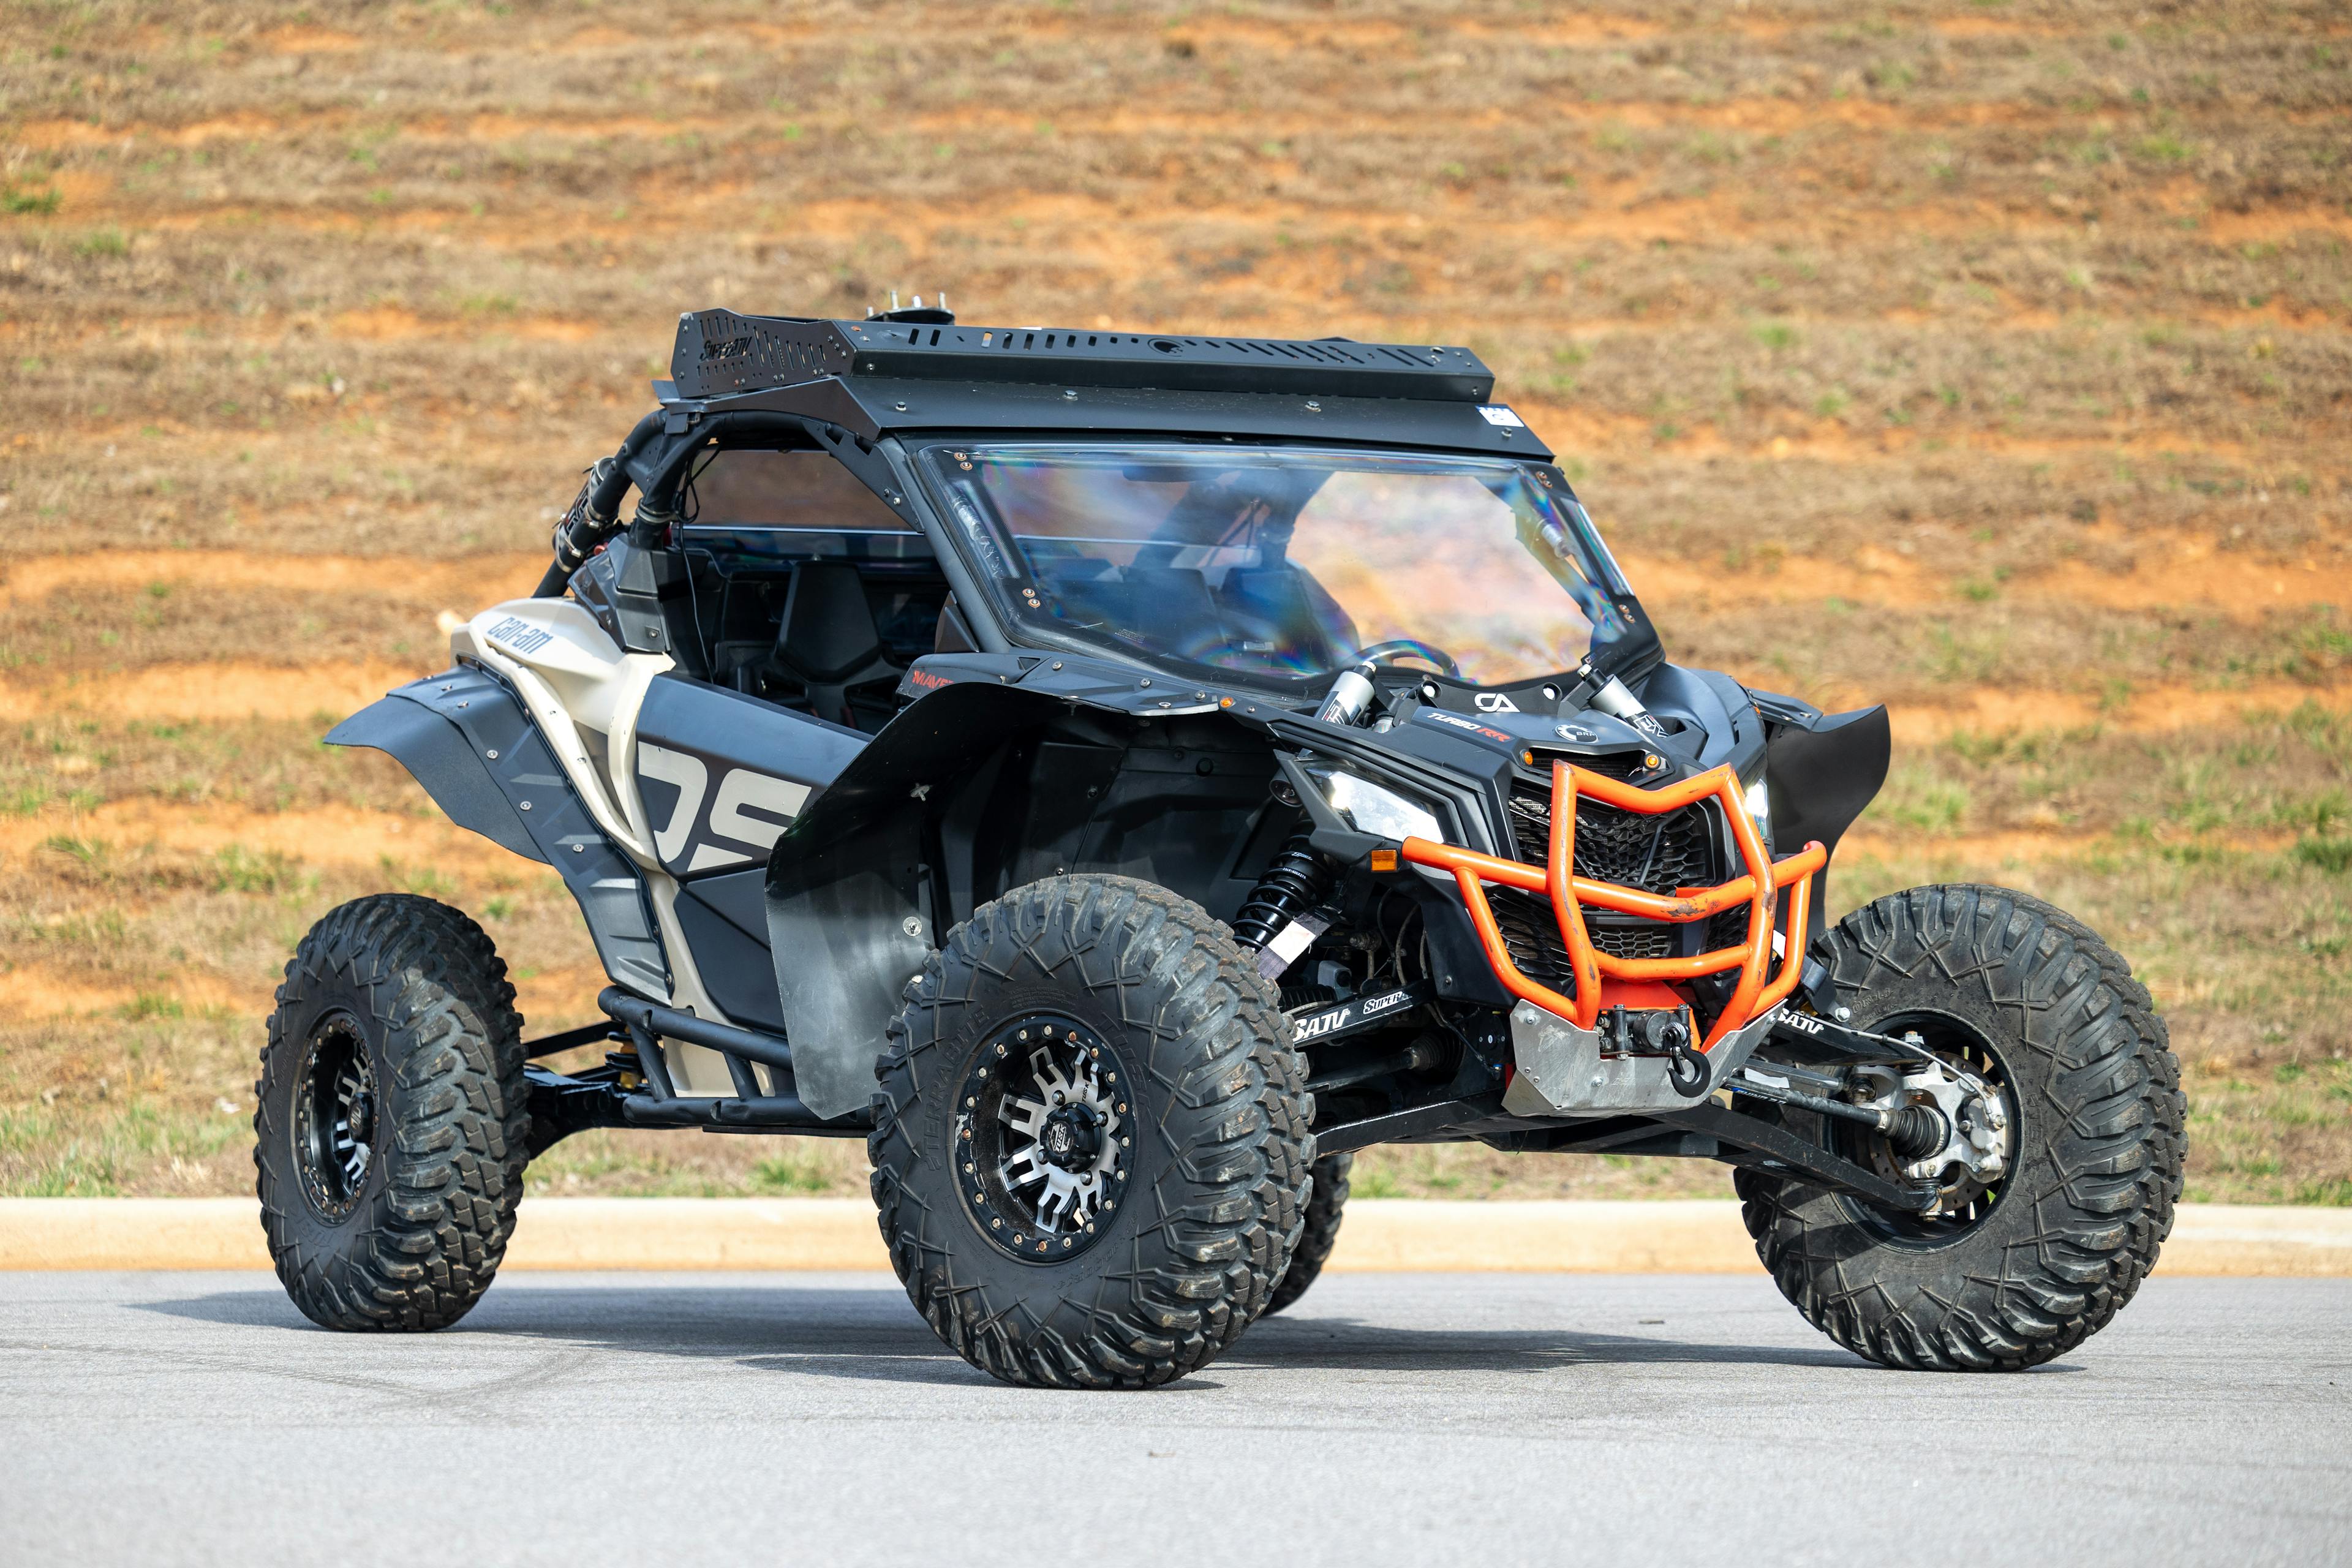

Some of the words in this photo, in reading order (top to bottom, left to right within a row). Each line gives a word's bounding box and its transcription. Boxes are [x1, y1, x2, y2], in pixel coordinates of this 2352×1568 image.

[912, 669, 954, 689] MAVE
[1427, 712, 1481, 730] TURBO
[1476, 727, 1510, 742] RR
[924, 1005, 989, 1156] TERRABITE
[1100, 1012, 1154, 1127] TUSK
[1054, 1123, 1066, 1152] TUSK
